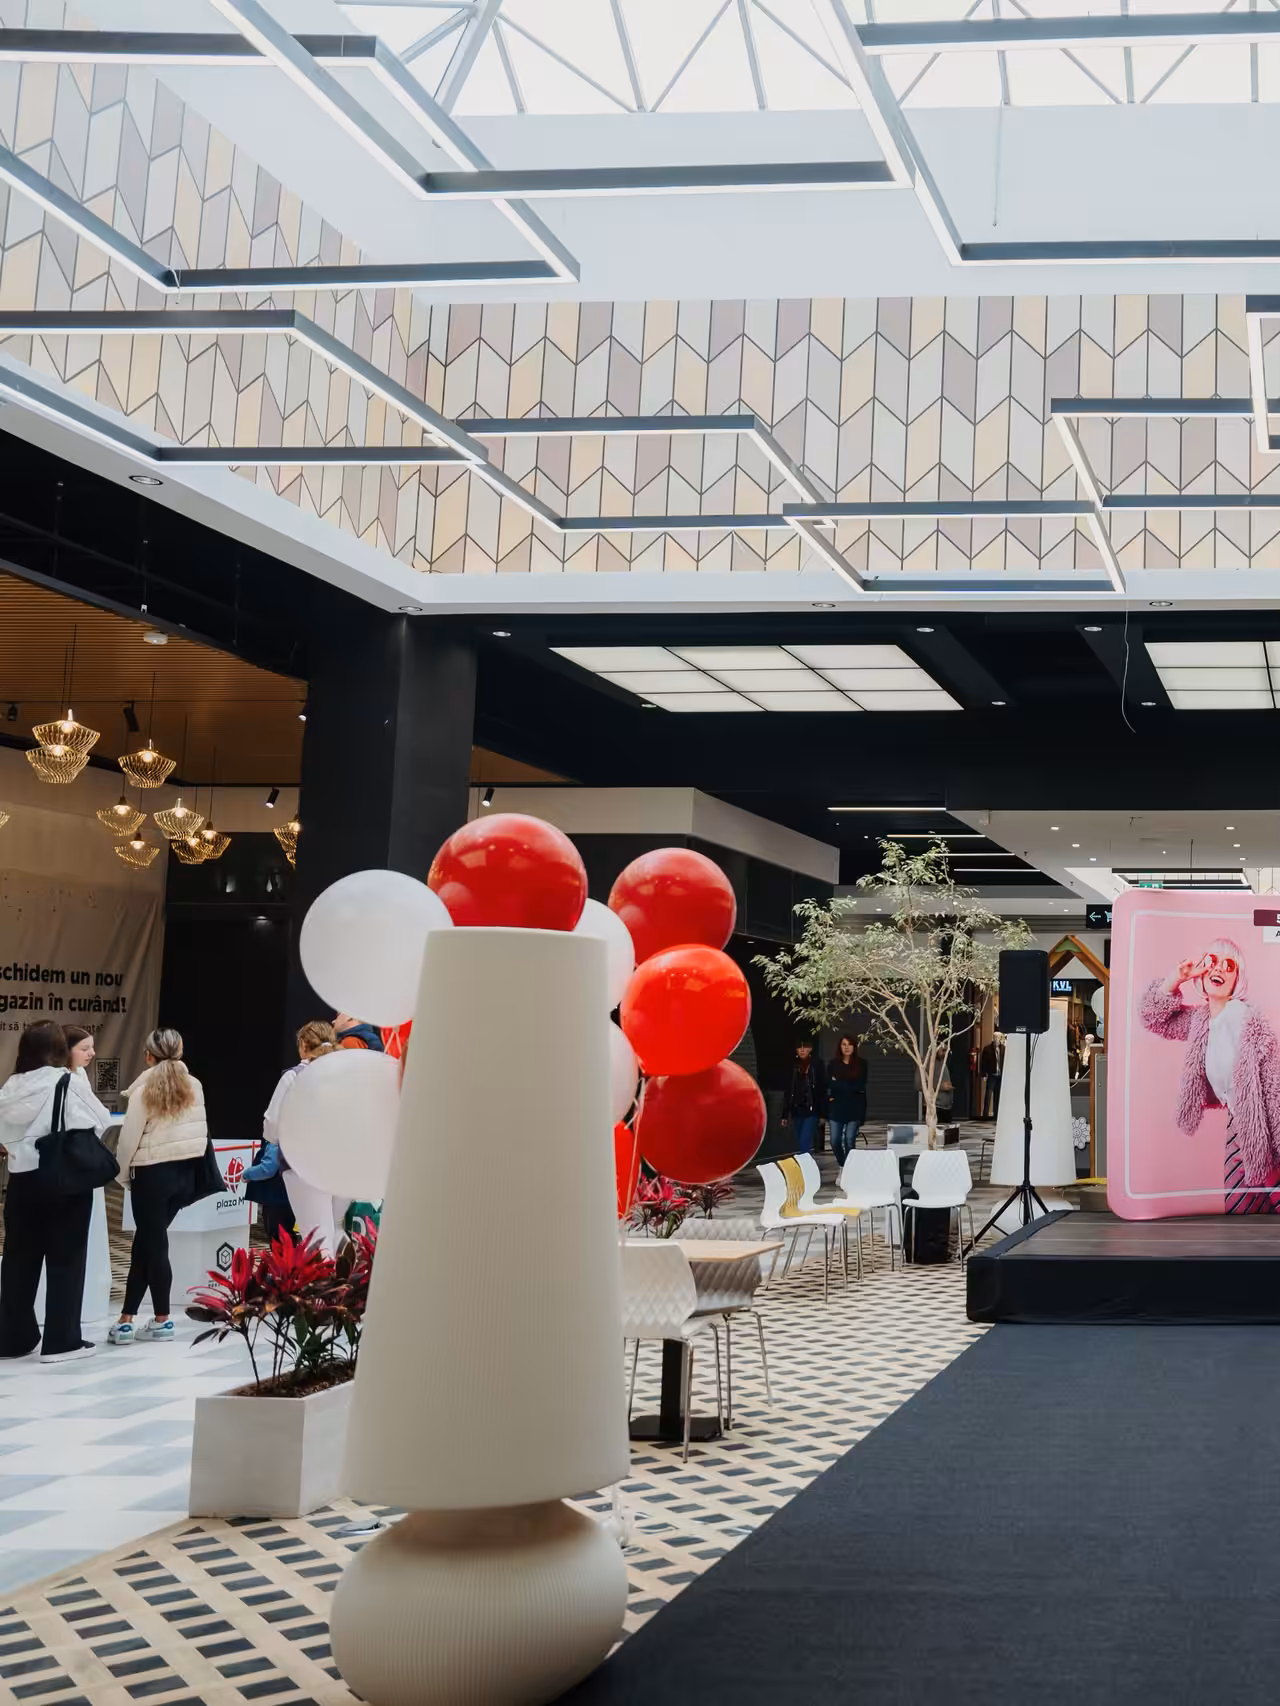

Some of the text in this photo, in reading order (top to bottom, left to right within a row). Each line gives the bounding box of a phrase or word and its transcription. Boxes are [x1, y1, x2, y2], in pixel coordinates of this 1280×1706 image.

[0, 962, 124, 987] chidem un nou
[1052, 980, 1072, 989] KVL
[47, 992, 64, 1011] în
[68, 994, 127, 1013] curând!
[216, 1199, 237, 1211] plaza
